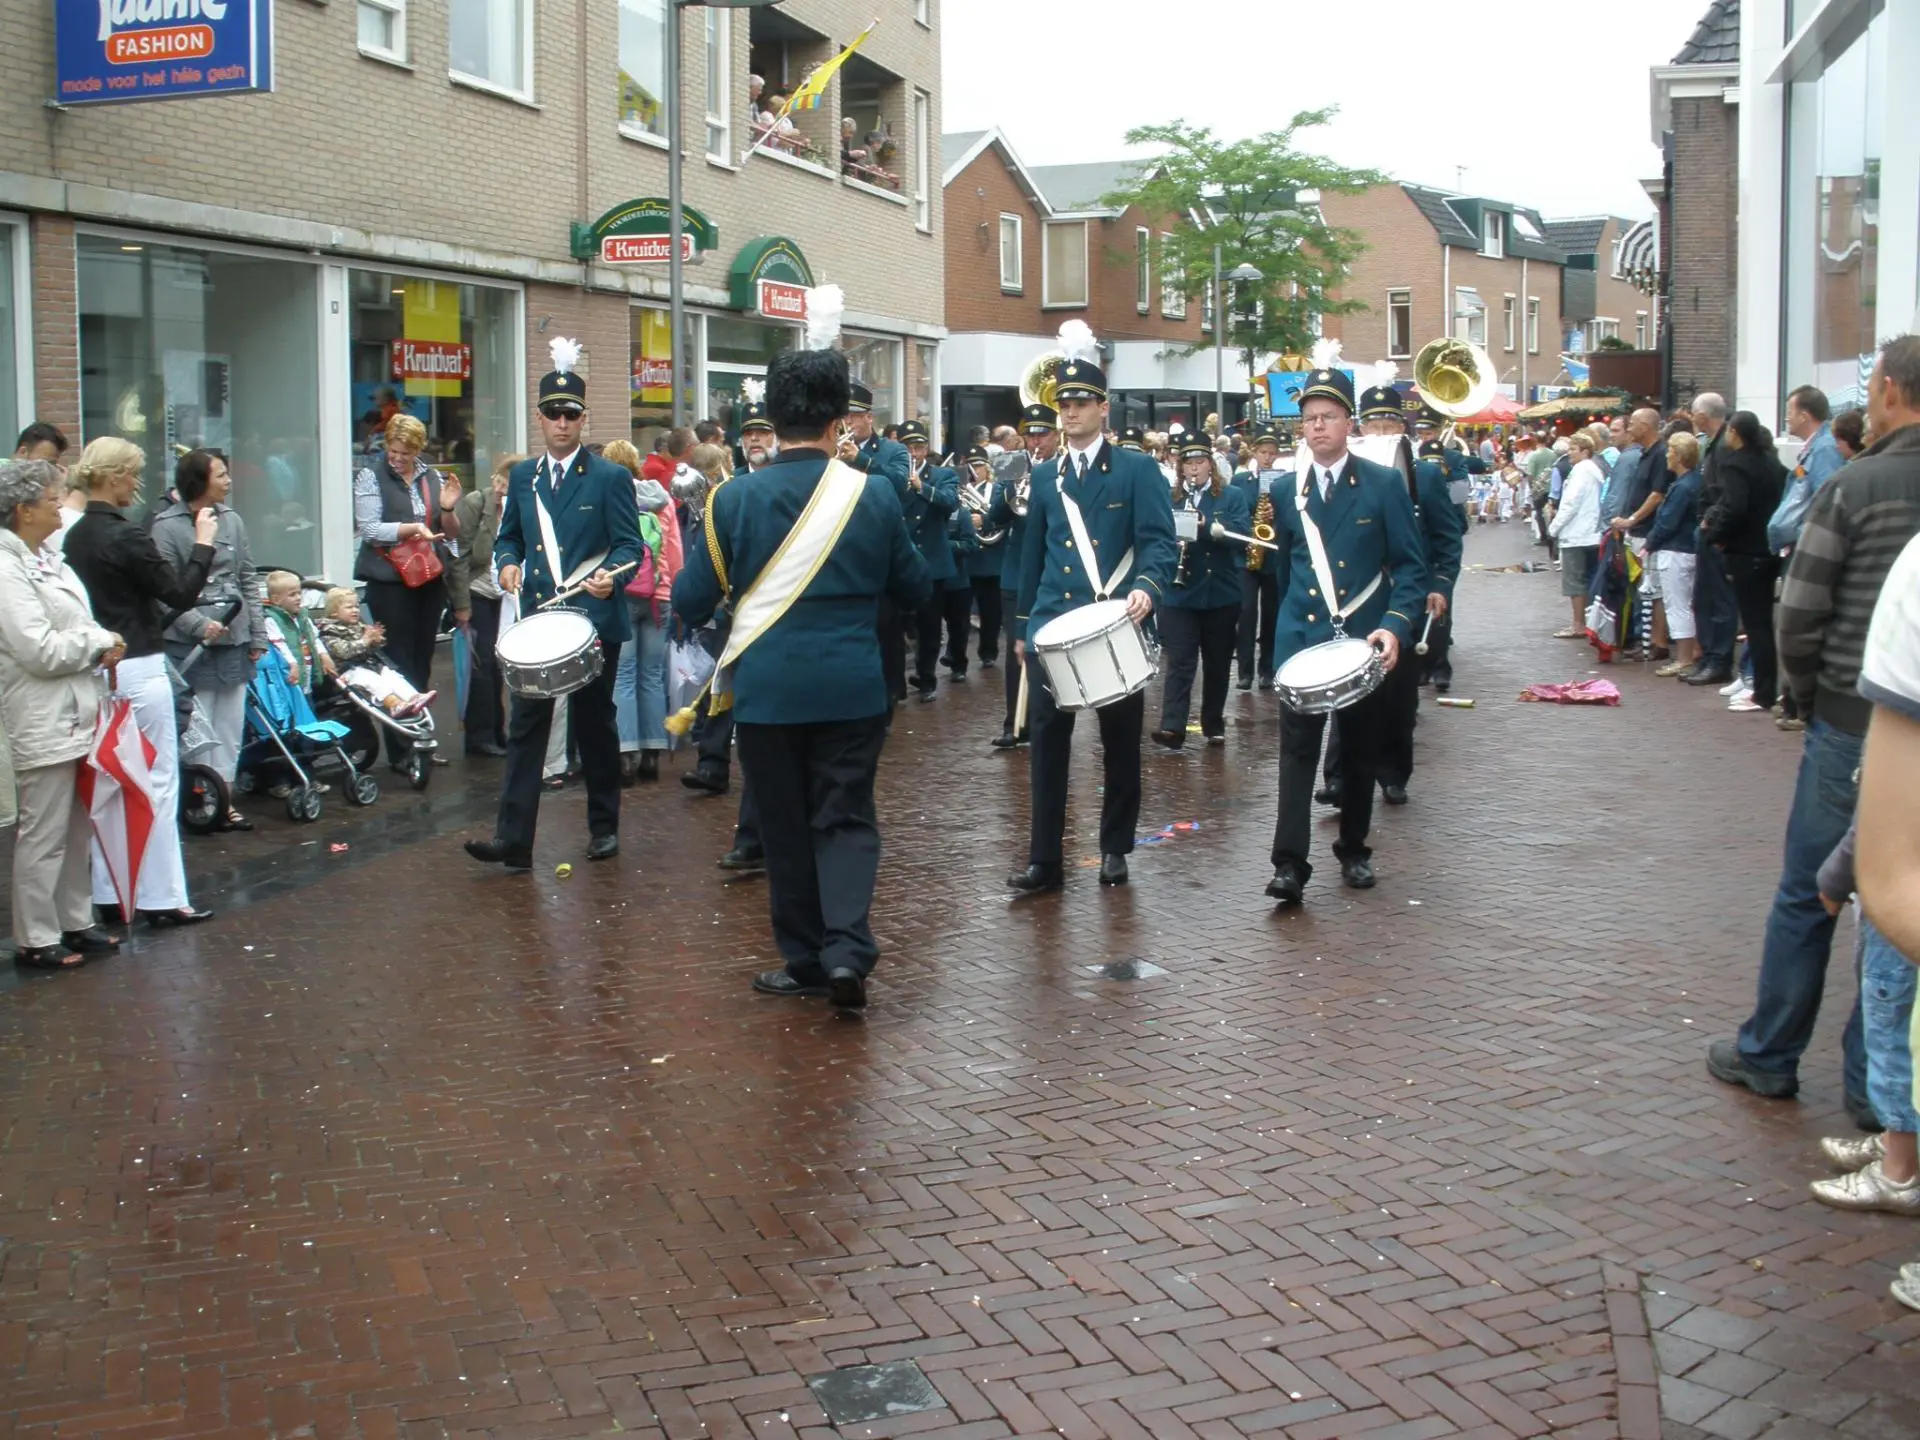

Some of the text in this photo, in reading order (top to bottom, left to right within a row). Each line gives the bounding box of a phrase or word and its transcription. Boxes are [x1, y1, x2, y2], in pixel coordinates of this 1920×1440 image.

[116, 31, 204, 57] FASHION
[62, 76, 102, 93] mode
[106, 75, 140, 89] voor
[143, 68, 166, 87] het
[207, 63, 245, 85] gezin
[615, 240, 672, 258] Kruidva
[771, 288, 802, 313] Kruidvat
[403, 343, 462, 374] Kruidvat
